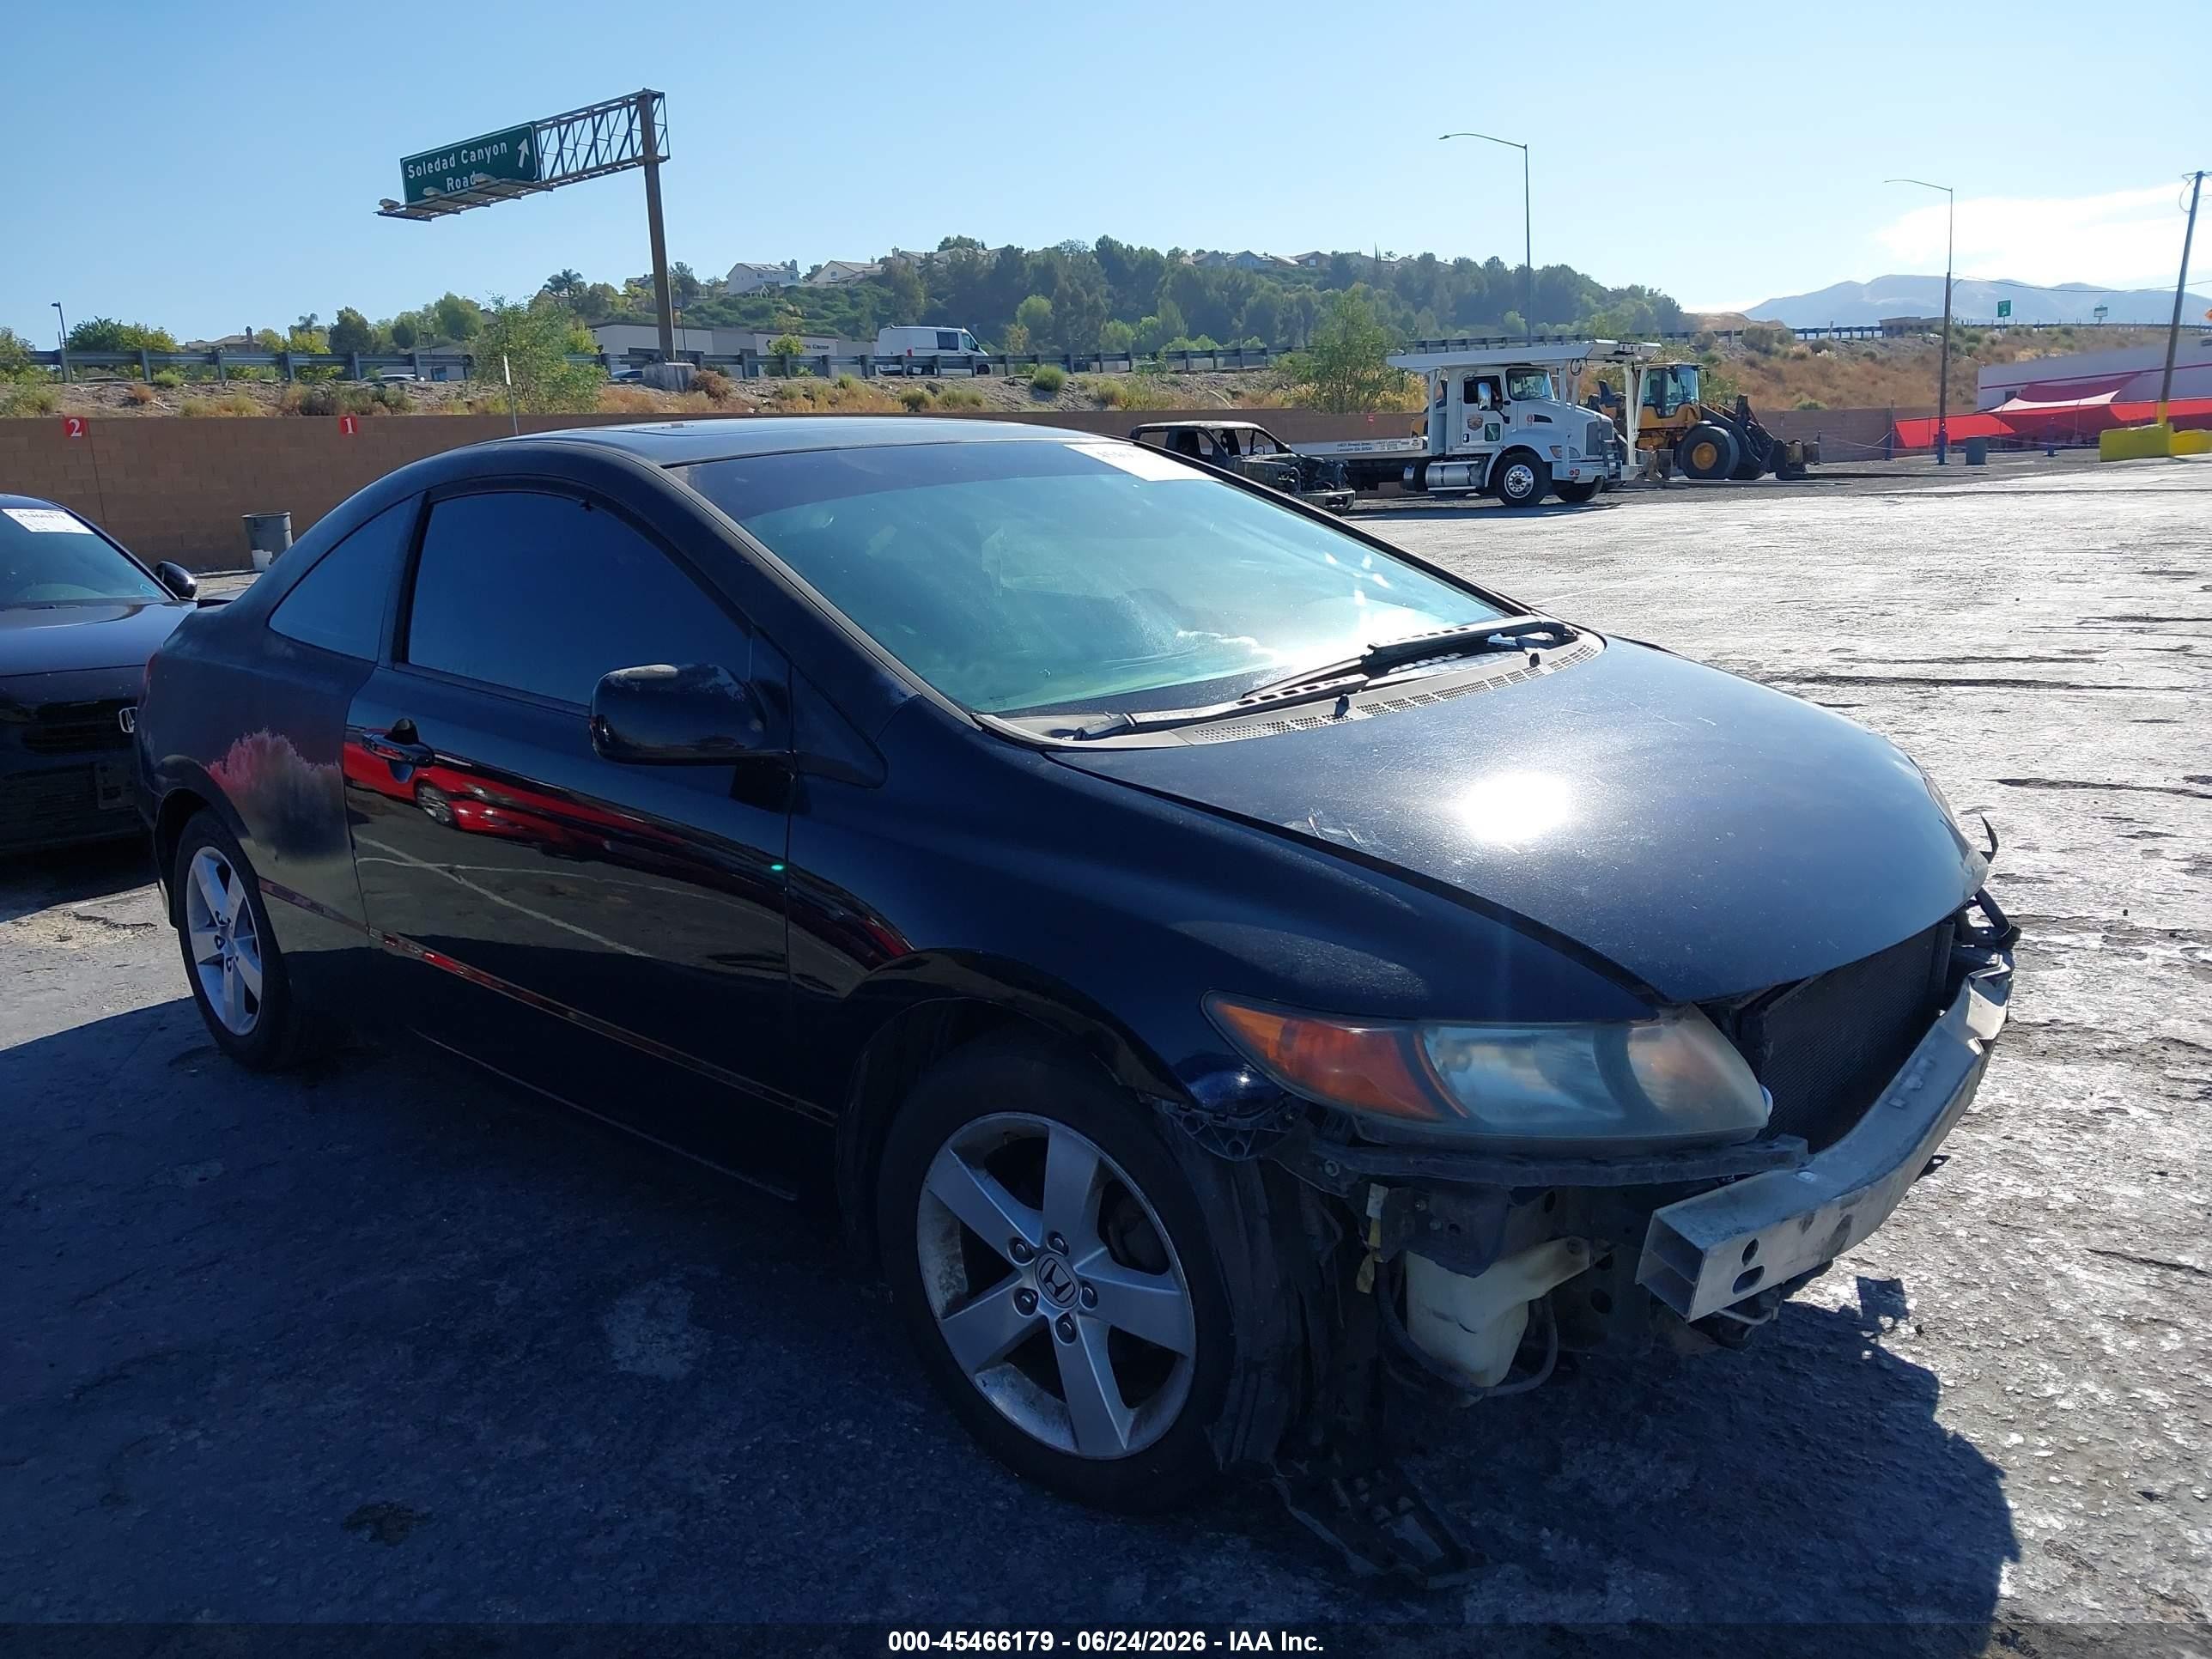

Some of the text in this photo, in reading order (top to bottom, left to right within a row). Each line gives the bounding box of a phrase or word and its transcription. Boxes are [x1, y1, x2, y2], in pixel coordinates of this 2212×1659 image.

[407, 142, 507, 179] Soledad Canyon
[447, 170, 477, 191] Road
[69, 418, 82, 436] 2
[345, 417, 353, 433] 1
